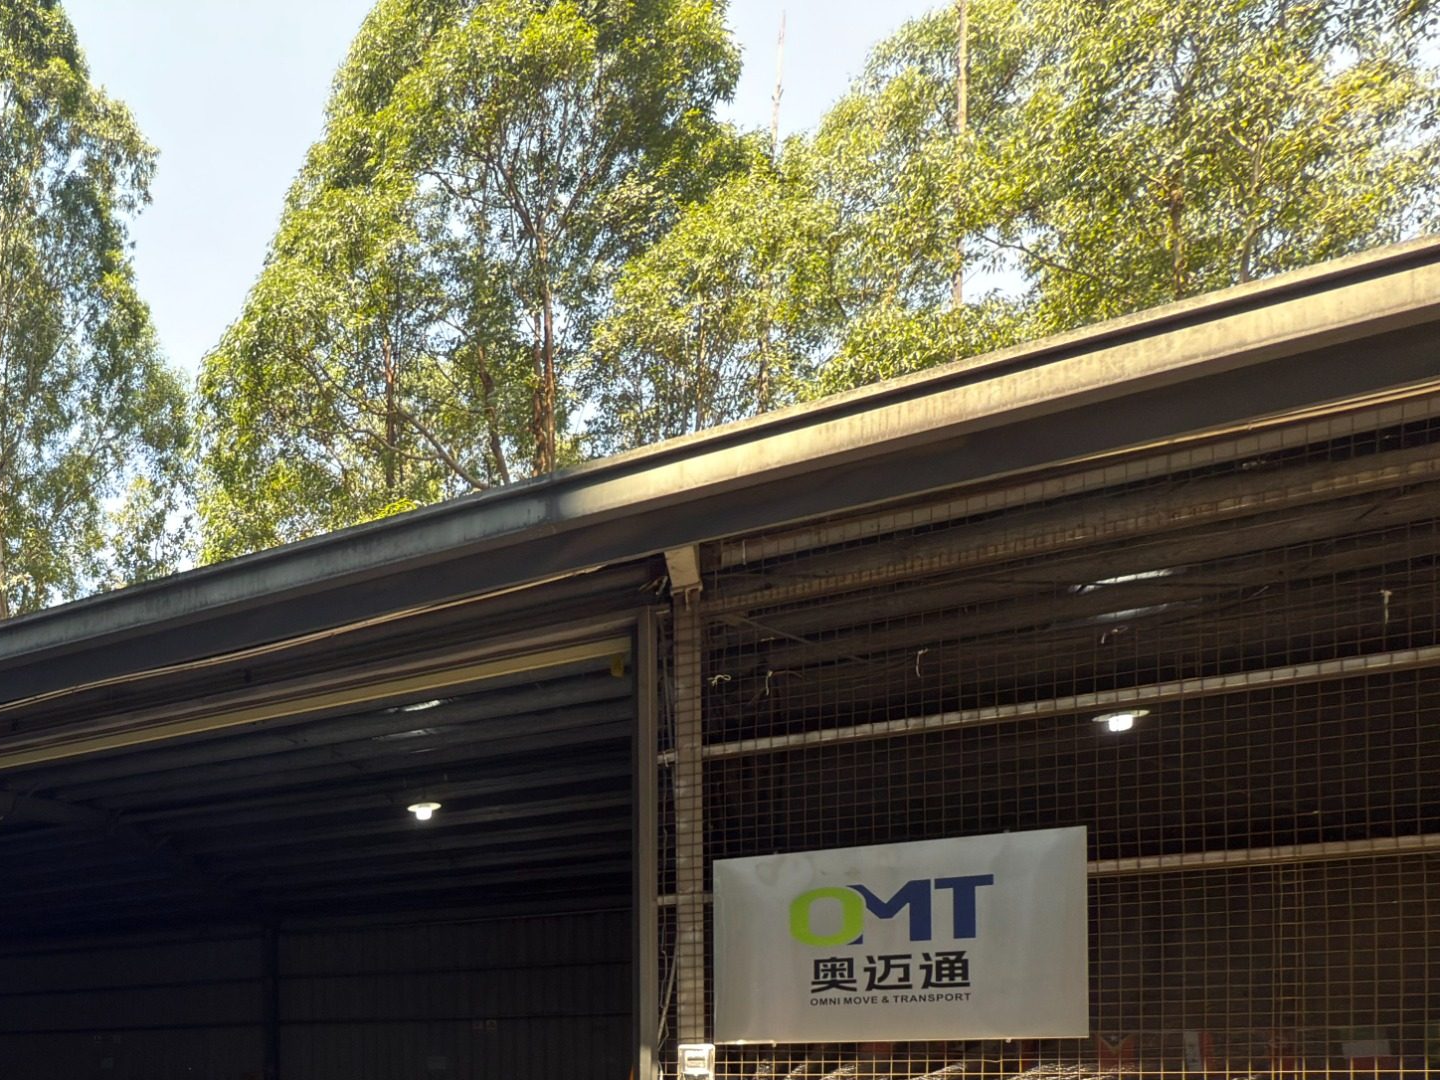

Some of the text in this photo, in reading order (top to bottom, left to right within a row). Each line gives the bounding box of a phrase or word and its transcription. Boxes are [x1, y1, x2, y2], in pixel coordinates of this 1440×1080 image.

[788, 873, 995, 948] OMT
[810, 950, 971, 994] 奥迈通
[810, 992, 972, 1007] OMNI MOVE & TRANSPORT
